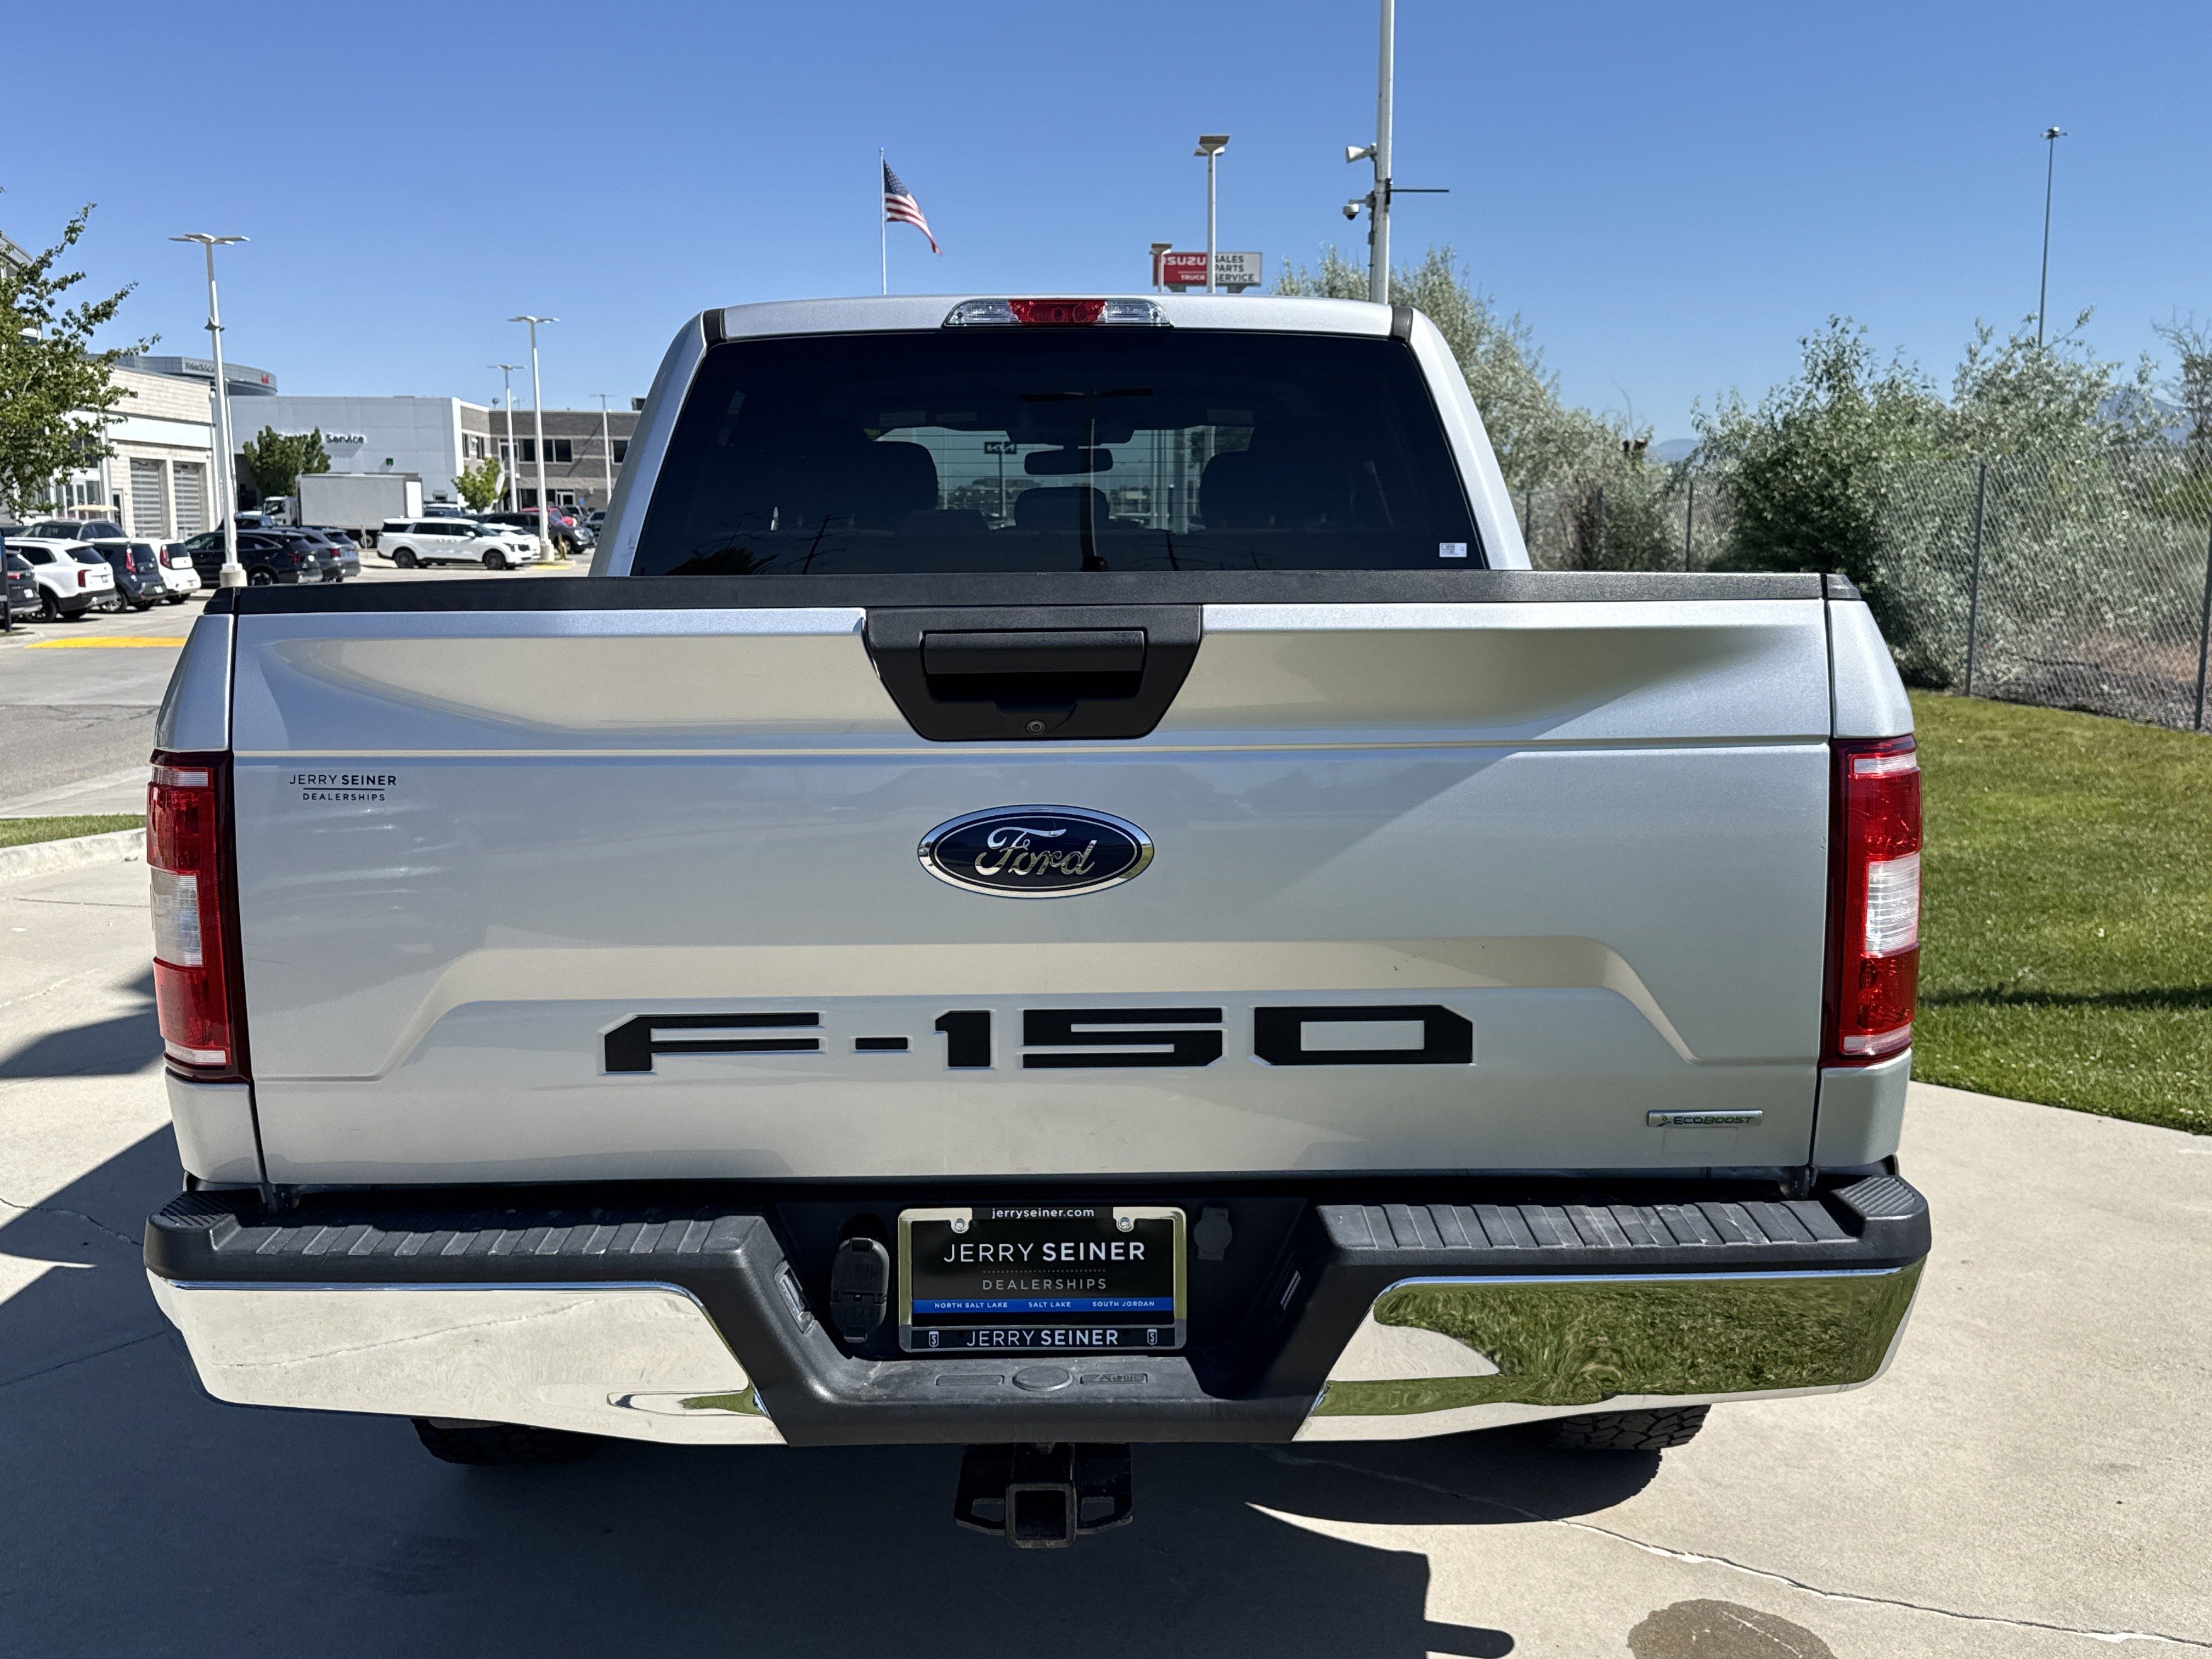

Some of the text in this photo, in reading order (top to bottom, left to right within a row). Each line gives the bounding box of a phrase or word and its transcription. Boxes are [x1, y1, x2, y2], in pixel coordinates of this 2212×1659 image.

[1163, 256, 1206, 266] ISUZU
[289, 774, 397, 786] JERRY SEINER
[302, 793, 385, 802] DEALERSHIPS
[974, 826, 1097, 876] Ford
[605, 1006, 1474, 1073] F-150
[991, 1207, 1094, 1220] jerryseiner.com
[943, 1242, 1146, 1262] JERRY SEINER
[983, 1278, 1107, 1290] DEALERSHIPS
[966, 1329, 1118, 1347] JERRY SEINER
